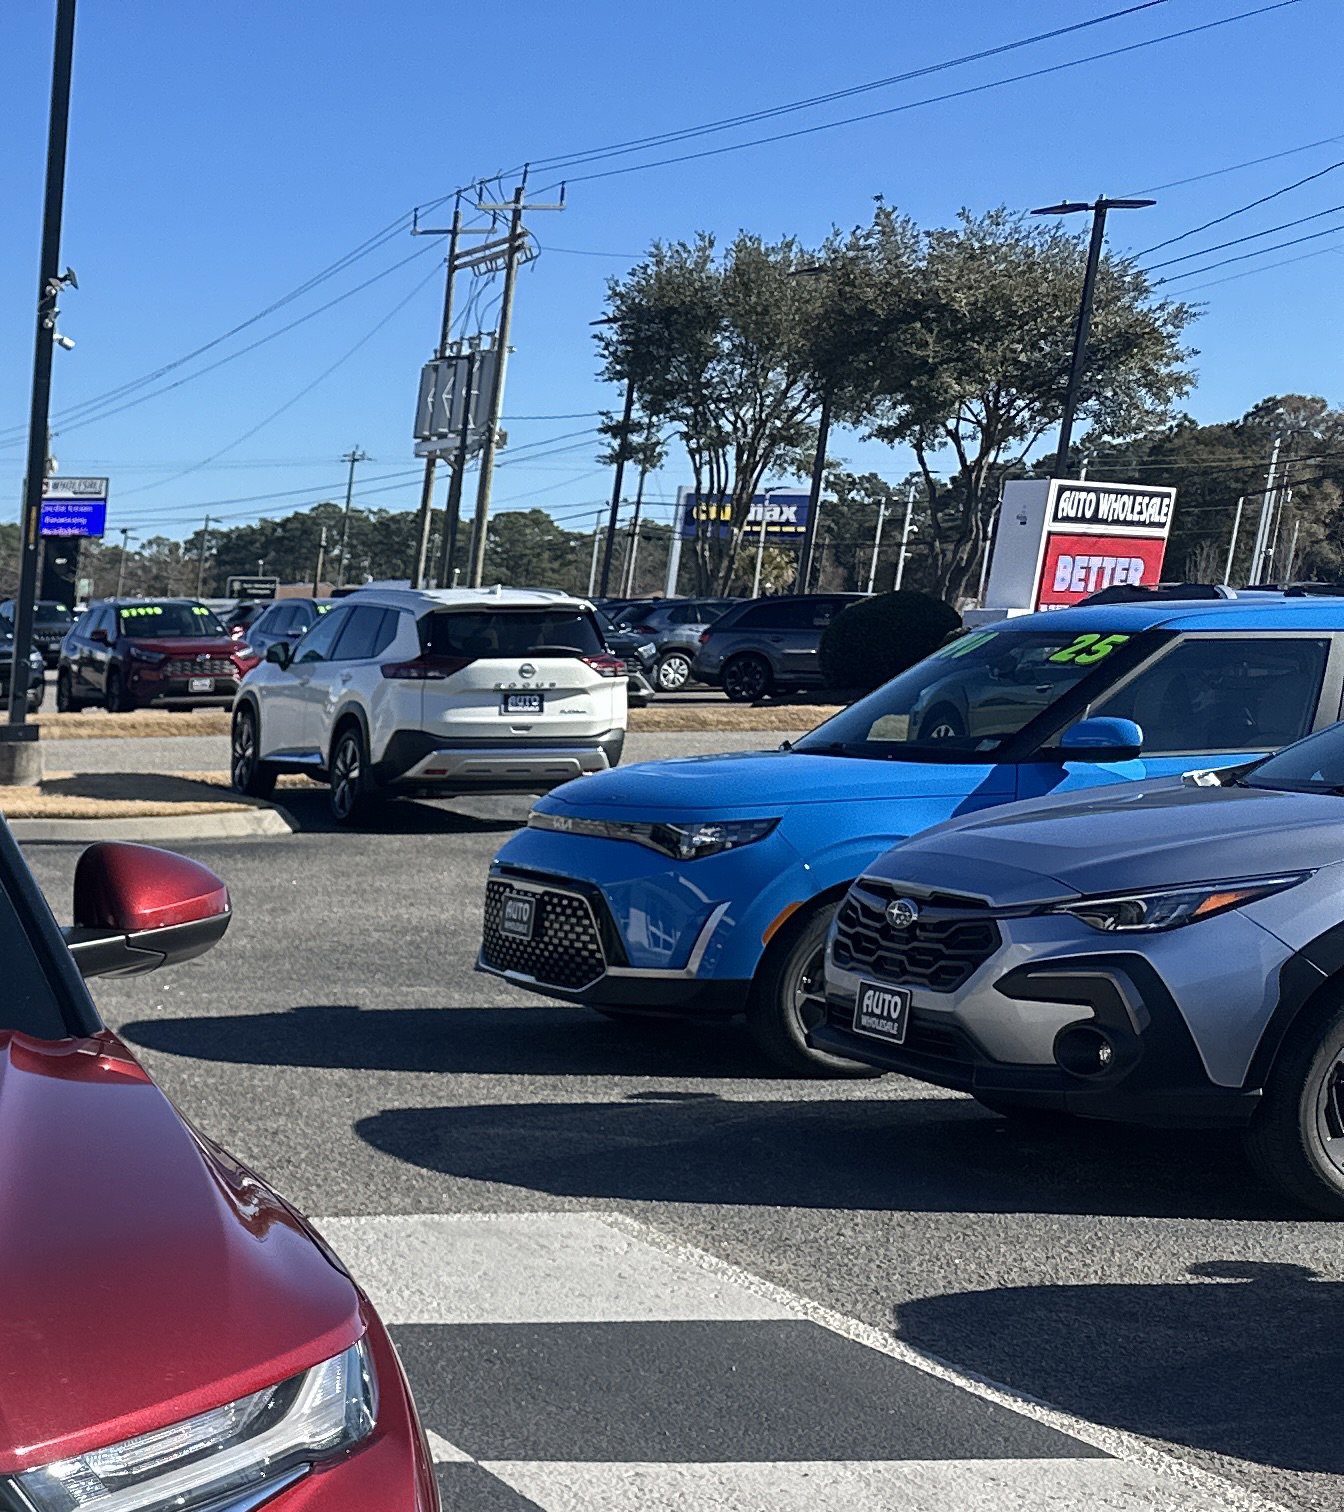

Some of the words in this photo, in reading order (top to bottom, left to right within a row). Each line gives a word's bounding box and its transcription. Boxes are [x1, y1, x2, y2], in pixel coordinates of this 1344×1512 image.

[1057, 490, 1097, 519] AUTO
[1097, 493, 1171, 524] WHOLESALE
[1053, 555, 1145, 592] BETTER
[1048, 633, 1131, 666] 25
[508, 695, 540, 706] AUTO
[505, 900, 531, 921] AUTO
[863, 989, 902, 1019] AUTO
[861, 1014, 899, 1035] WHOLESALE
